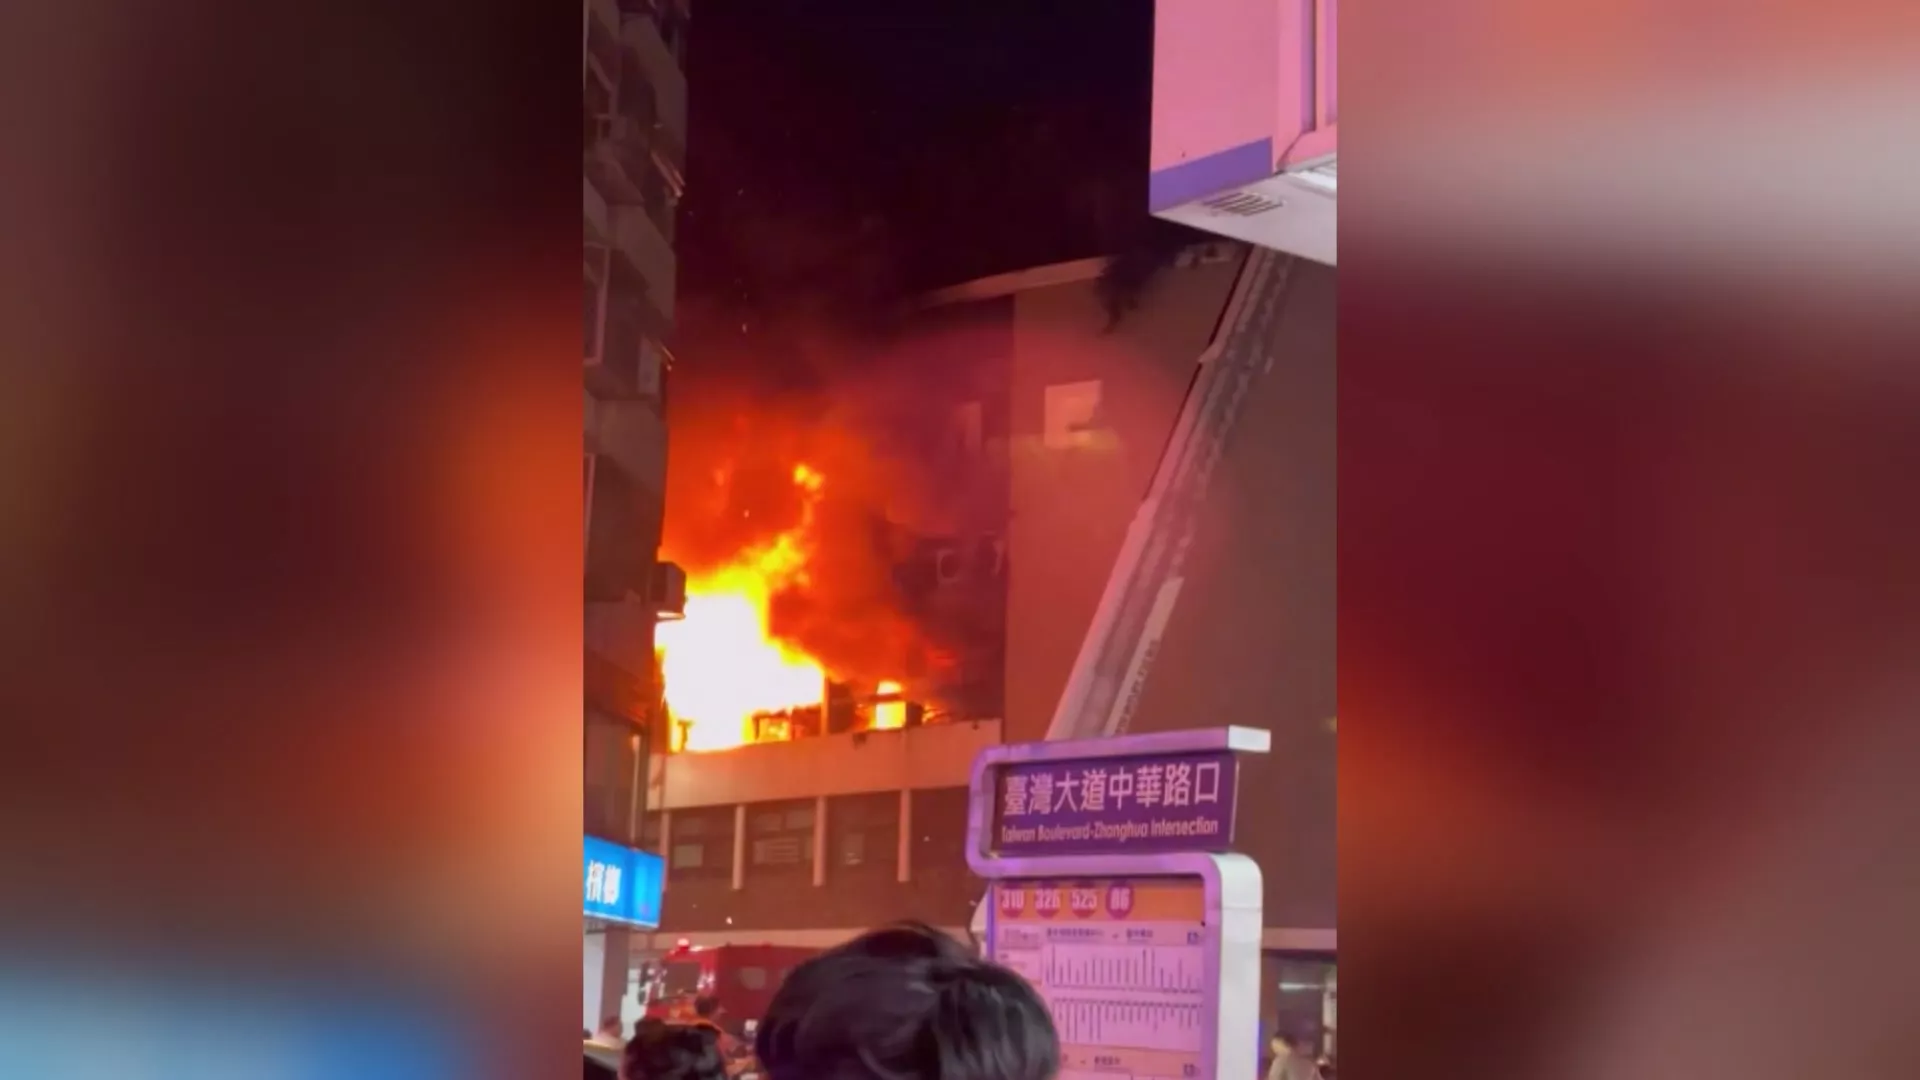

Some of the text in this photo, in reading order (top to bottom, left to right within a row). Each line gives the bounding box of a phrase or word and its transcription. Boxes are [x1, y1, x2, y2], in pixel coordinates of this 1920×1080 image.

[1003, 762, 1220, 816] 臺灣大道中華路口
[1151, 816, 1218, 836] Intersection
[1001, 888, 1025, 909] 310
[1034, 888, 1060, 909] 326
[1071, 888, 1098, 909] 525
